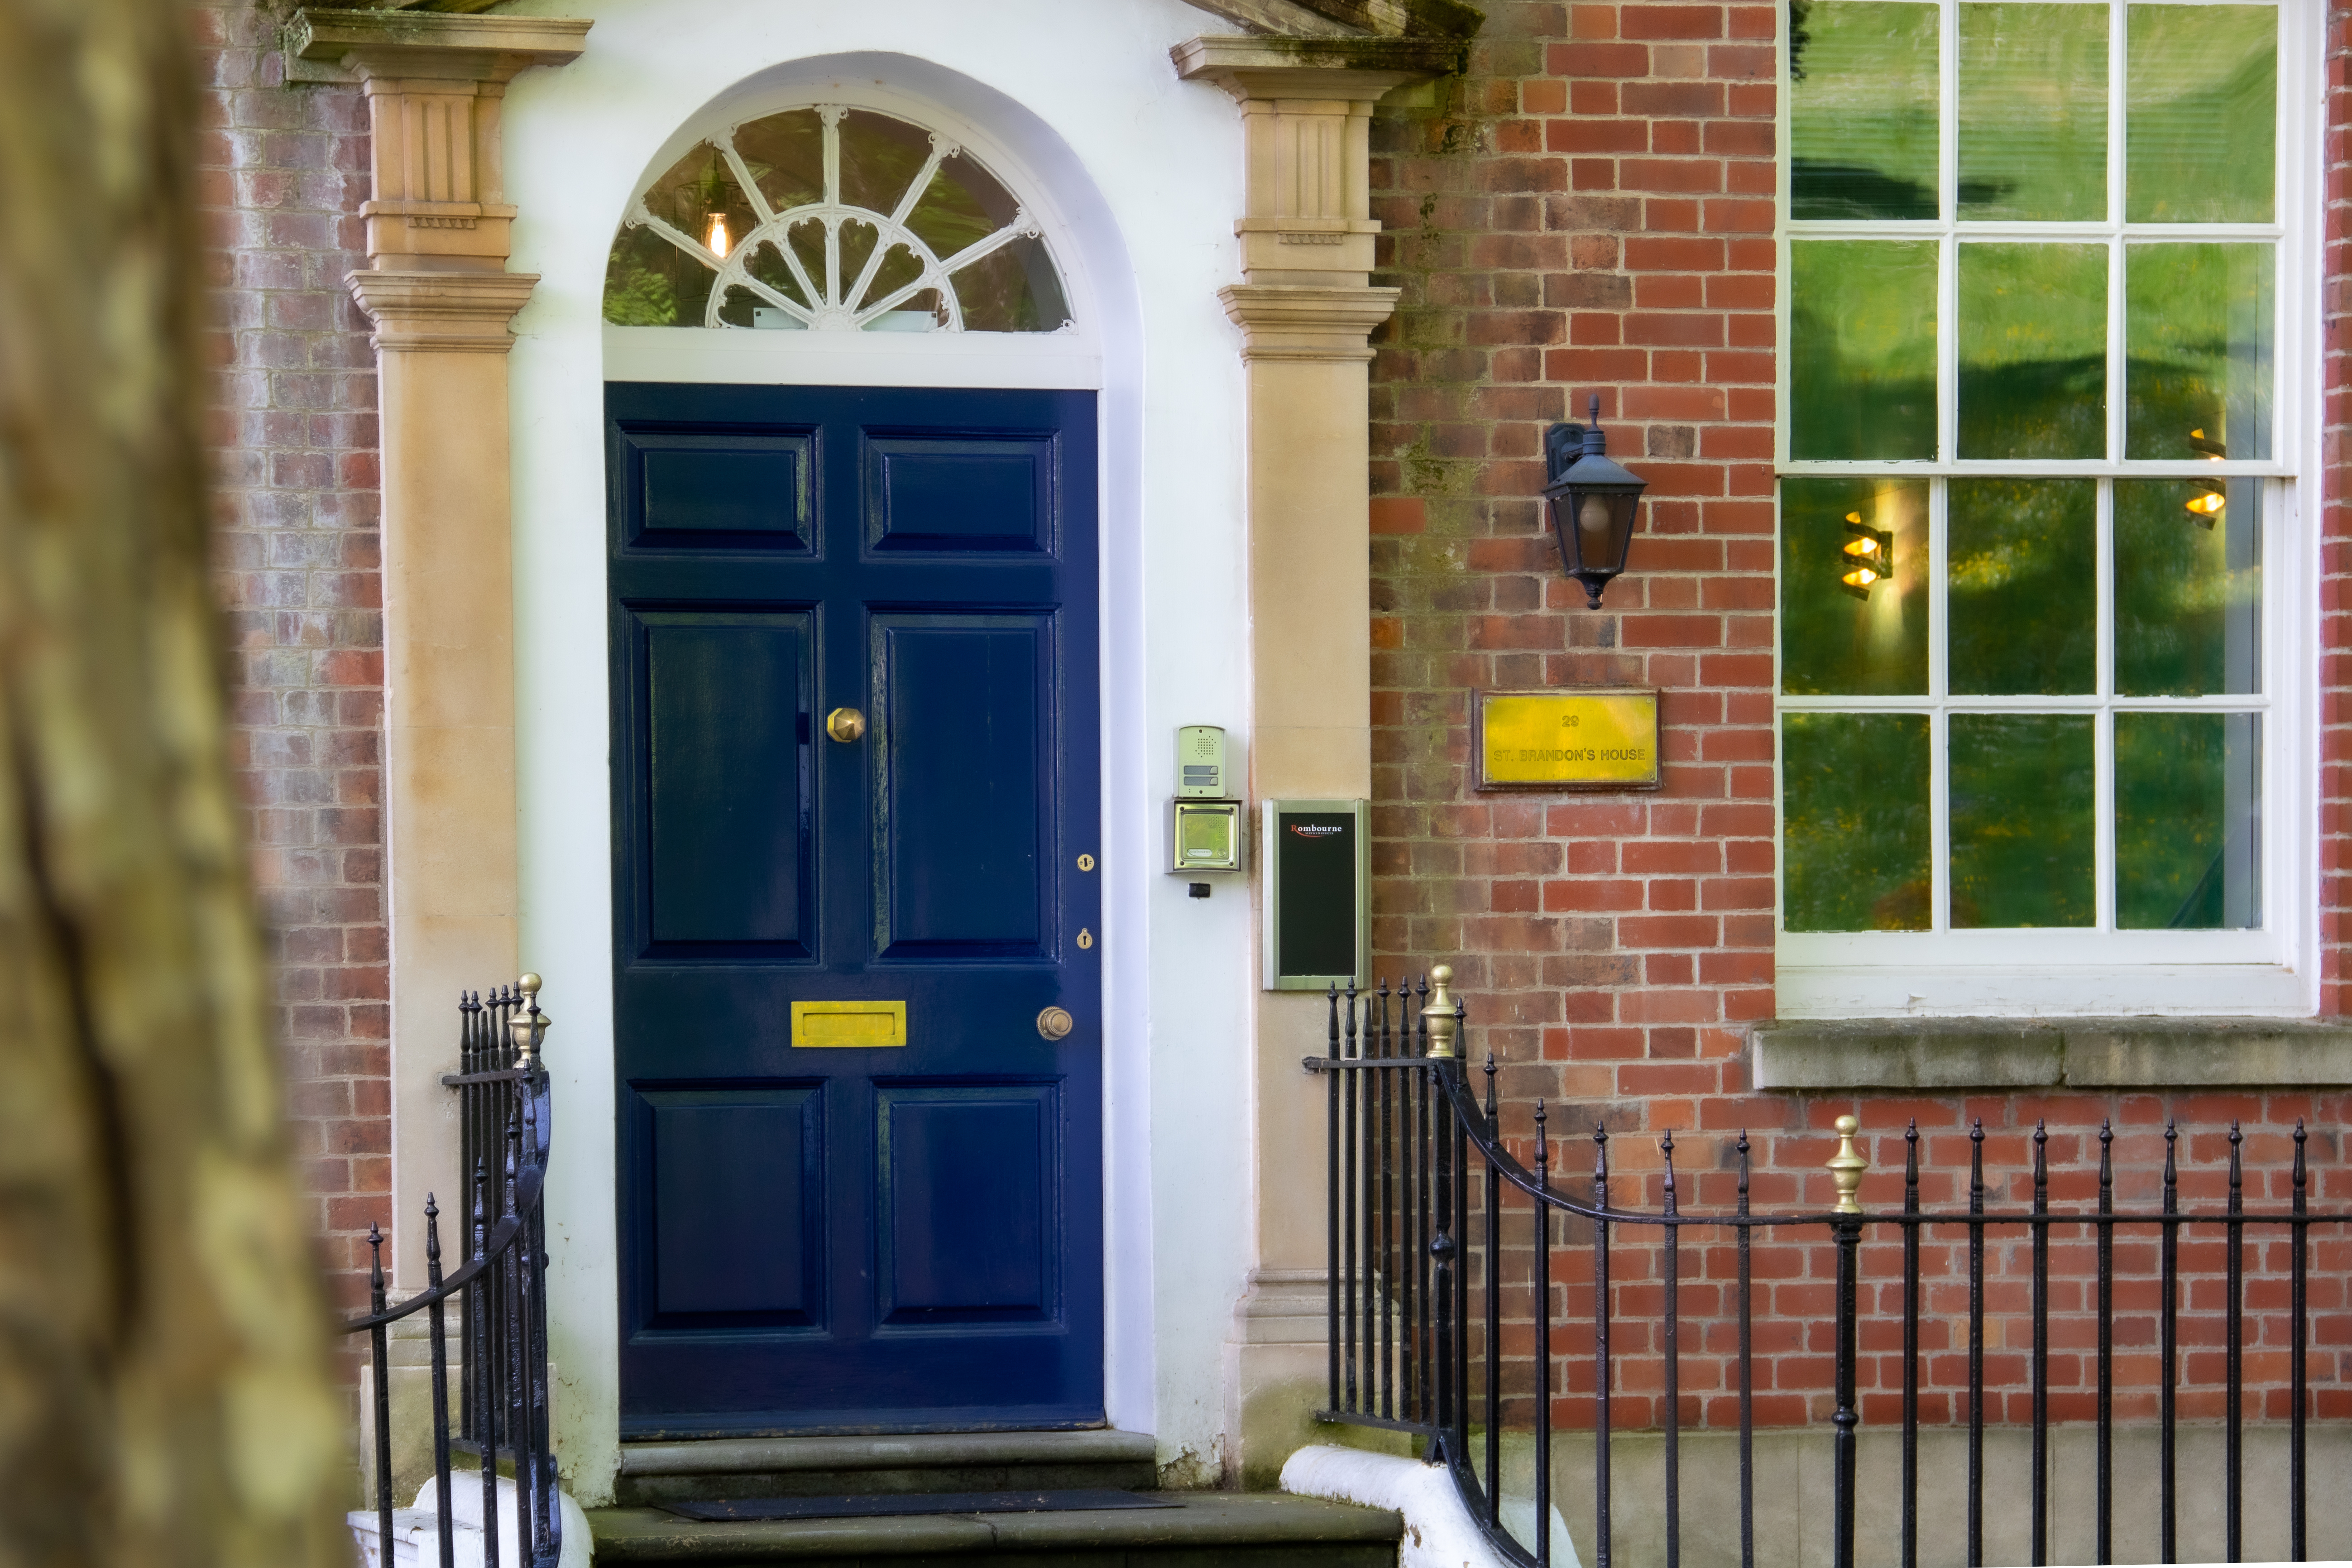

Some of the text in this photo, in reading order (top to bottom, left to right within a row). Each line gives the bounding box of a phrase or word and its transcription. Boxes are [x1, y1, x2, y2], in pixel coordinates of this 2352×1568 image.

[1562, 715, 1579, 727] 29
[1494, 748, 1645, 762] ST. BRANDON'S HOUSE
[1291, 824, 1342, 832] Rombourne
